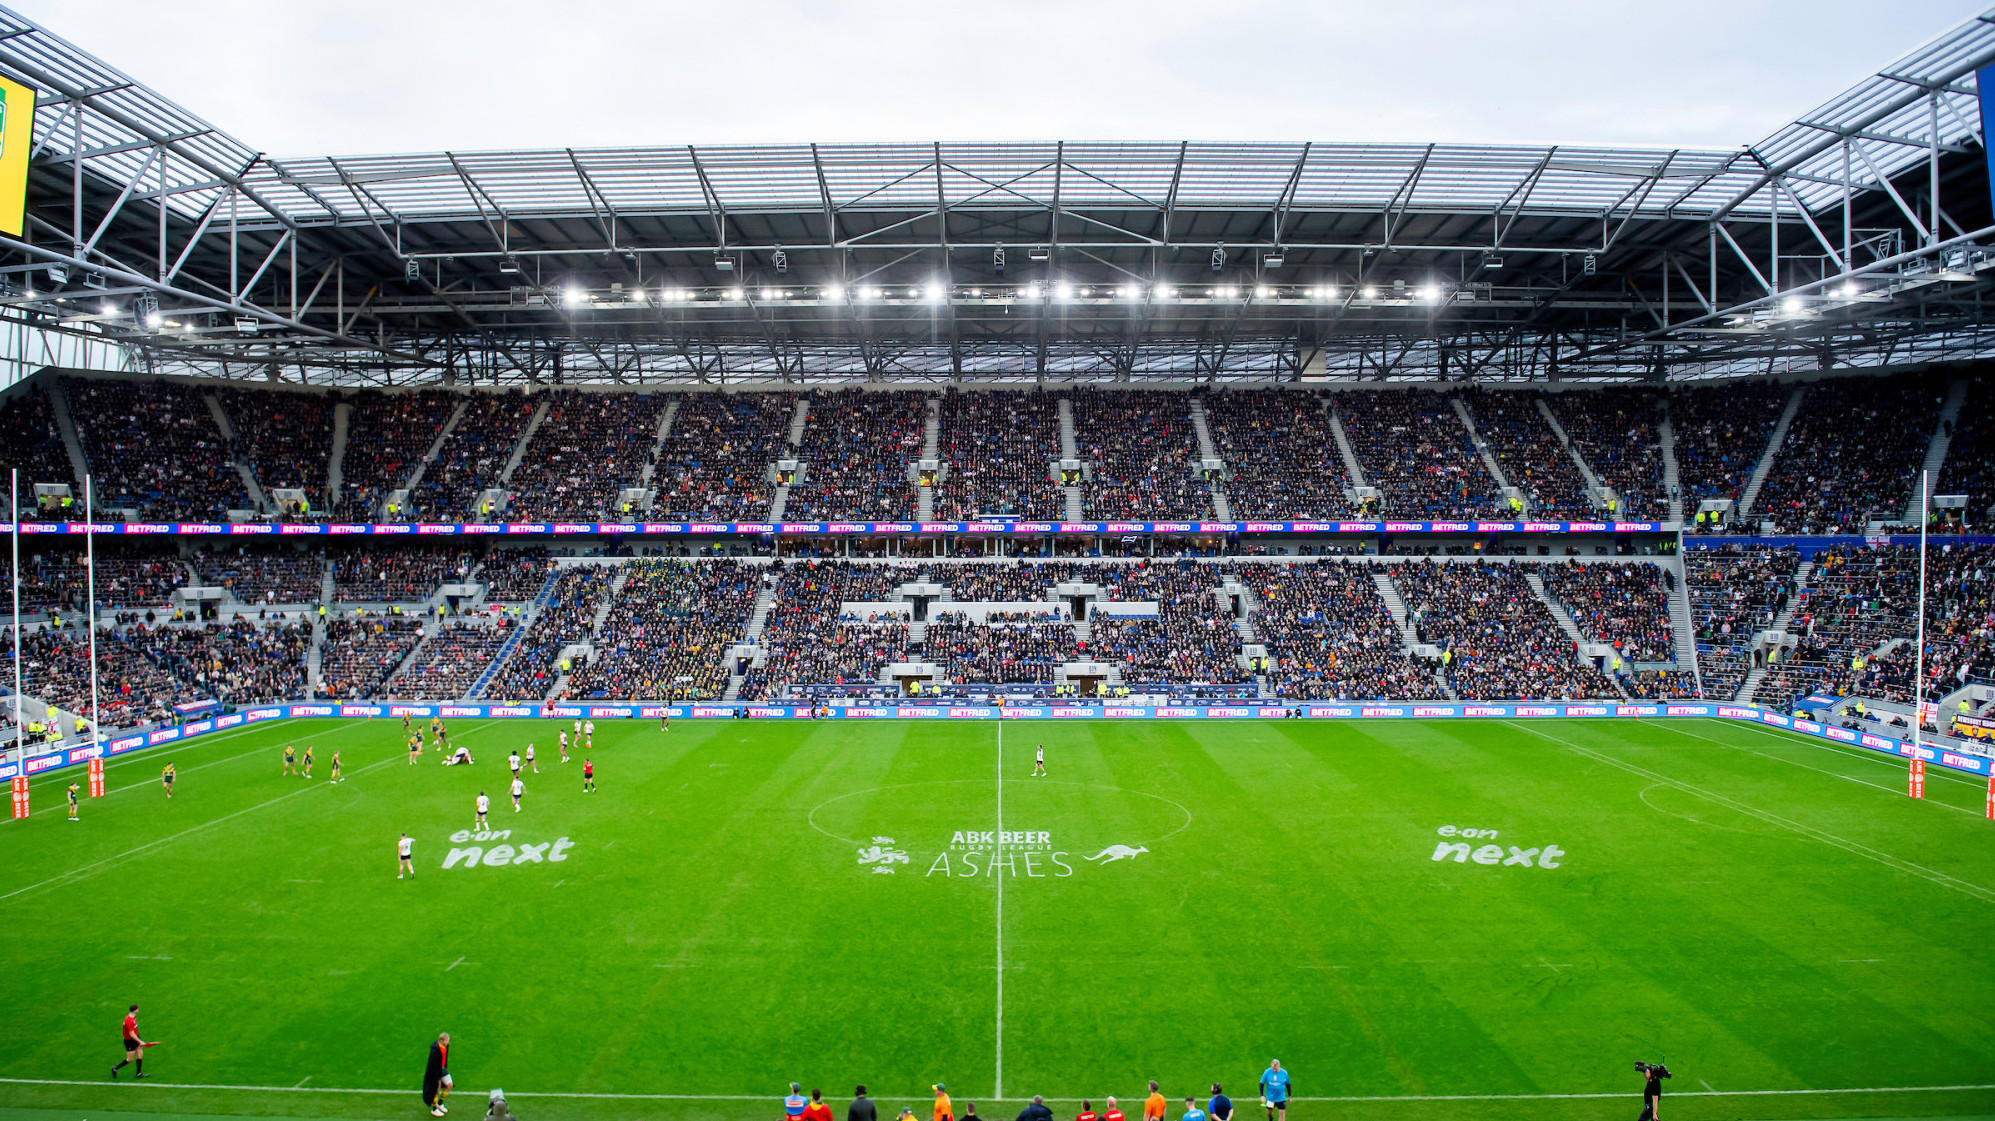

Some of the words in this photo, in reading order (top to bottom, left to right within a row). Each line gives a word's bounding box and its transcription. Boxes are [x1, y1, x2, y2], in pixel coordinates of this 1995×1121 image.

[22, 524, 57, 533] BETFRED
[127, 524, 169, 533] BETFRED
[181, 524, 222, 533] BETFRED
[233, 524, 272, 532] BETFRED
[283, 524, 321, 532] BETFRED
[331, 524, 366, 532] BETFRED
[375, 524, 410, 532] BETFRED
[420, 524, 455, 532] BETFRED
[465, 524, 500, 532] BETFRED
[510, 524, 545, 532] BETFRED
[555, 524, 591, 532] BETFRED
[601, 524, 636, 532] BETFRED
[646, 524, 682, 532] BETFRED
[692, 524, 728, 532] BETFRED
[738, 524, 774, 532] BETFRED
[784, 524, 820, 532] BETFRED
[830, 524, 866, 532] BETFRED
[876, 524, 913, 532] BETFRED
[922, 524, 959, 532] BETFRED
[293, 708, 331, 716] BETFRED
[343, 708, 381, 716] BETFRED
[392, 708, 431, 716] BETFRED
[440, 708, 480, 716] BETFRED
[492, 708, 530, 716] BETFRED
[592, 708, 631, 717] BETFRED
[694, 708, 734, 717] BETFRED
[847, 708, 887, 717] BETFRED
[897, 708, 939, 717] BETFRED
[948, 709, 990, 717] BETFRED
[1001, 709, 1041, 717] BETFRED
[1052, 709, 1093, 717] BETFRED
[1104, 709, 1144, 717] BETFRED
[1156, 709, 1196, 717] BETFRED
[1209, 709, 1248, 717] BETFRED
[1311, 709, 1352, 717] BETFRED
[1363, 708, 1403, 717] BETFRED
[1414, 708, 1454, 717] BETFRED
[1465, 708, 1506, 717] BETFRED
[1517, 708, 1557, 717] BETFRED
[1567, 708, 1607, 716] BETFRED
[1617, 708, 1657, 716] BETFRED
[1668, 708, 1708, 716] BETFRED
[217, 715, 242, 727] BETFRED
[1764, 713, 1788, 725] BETFRED
[186, 721, 211, 734] BETFRED
[1794, 720, 1820, 733] BETFRED
[151, 729, 178, 742] BETFRED
[1827, 728, 1855, 740] BETFRED
[112, 737, 143, 751] BETFRED
[1862, 735, 1893, 749] BETFRED
[28, 755, 62, 771] BETFRED
[1944, 753, 1981, 769] BETFRED
[950, 831, 995, 844] ABK
[1000, 831, 1051, 844] BEER
[441, 837, 575, 869] next
[1431, 841, 1565, 869] next
[925, 852, 1073, 877] ASHES
